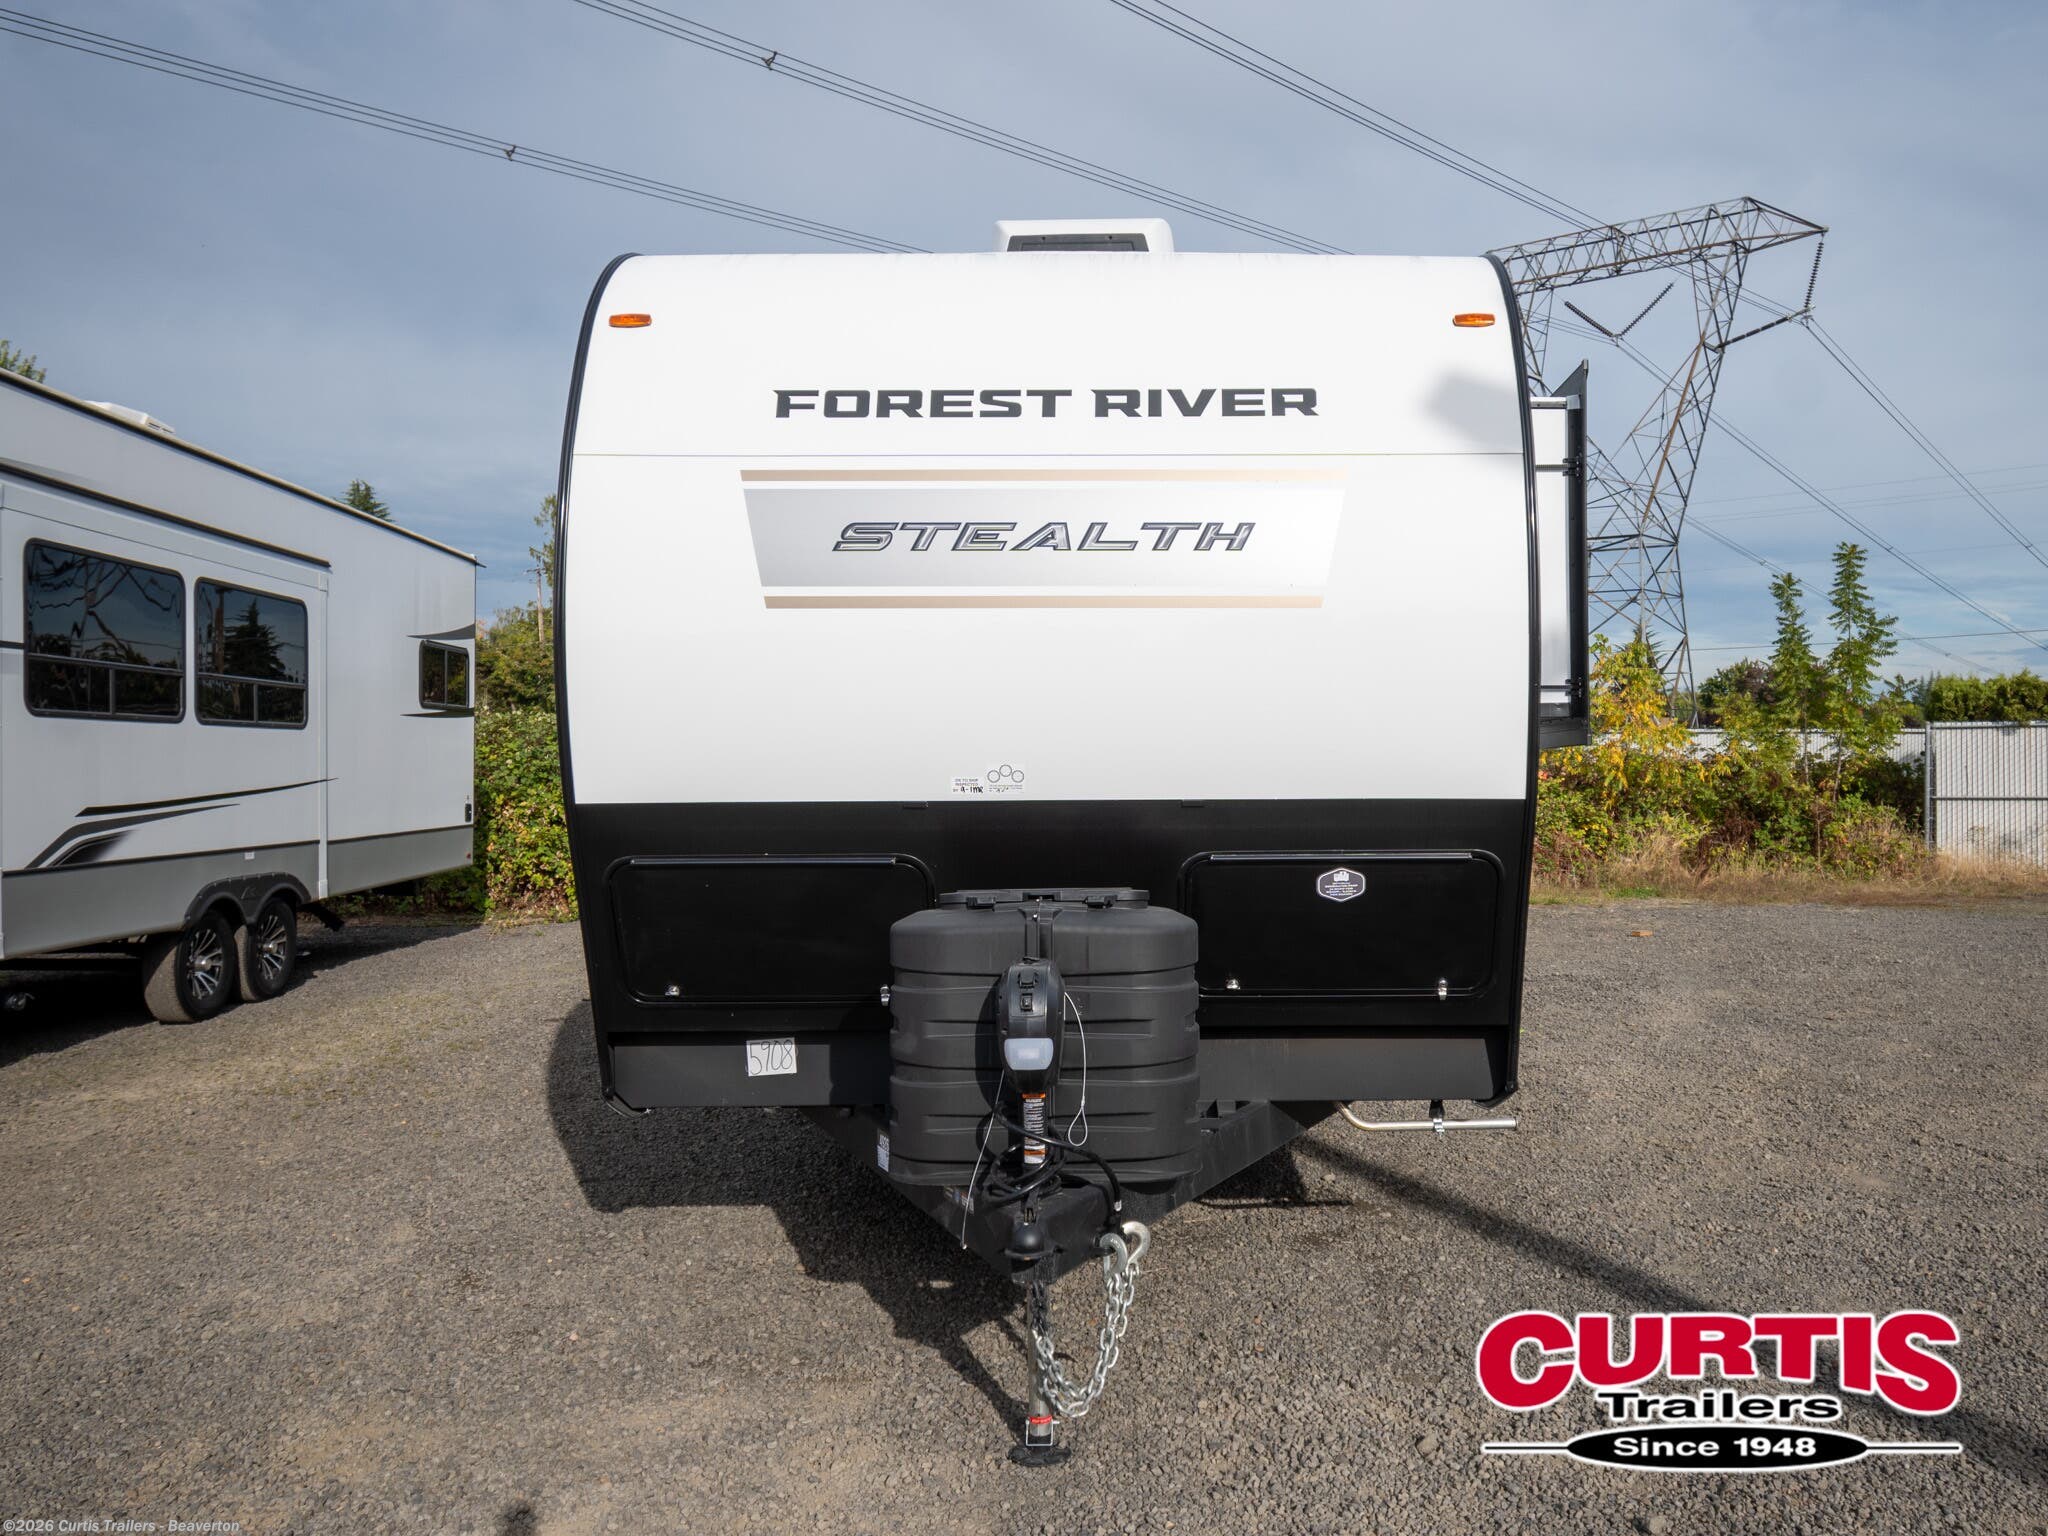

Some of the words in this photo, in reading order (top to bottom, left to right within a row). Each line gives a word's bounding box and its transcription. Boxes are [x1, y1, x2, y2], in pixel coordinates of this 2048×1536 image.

[773, 389, 1072, 418] FOREST
[1091, 388, 1319, 418] RIVER
[831, 521, 1256, 551] STEALTH
[750, 1039, 793, 1075] 5908
